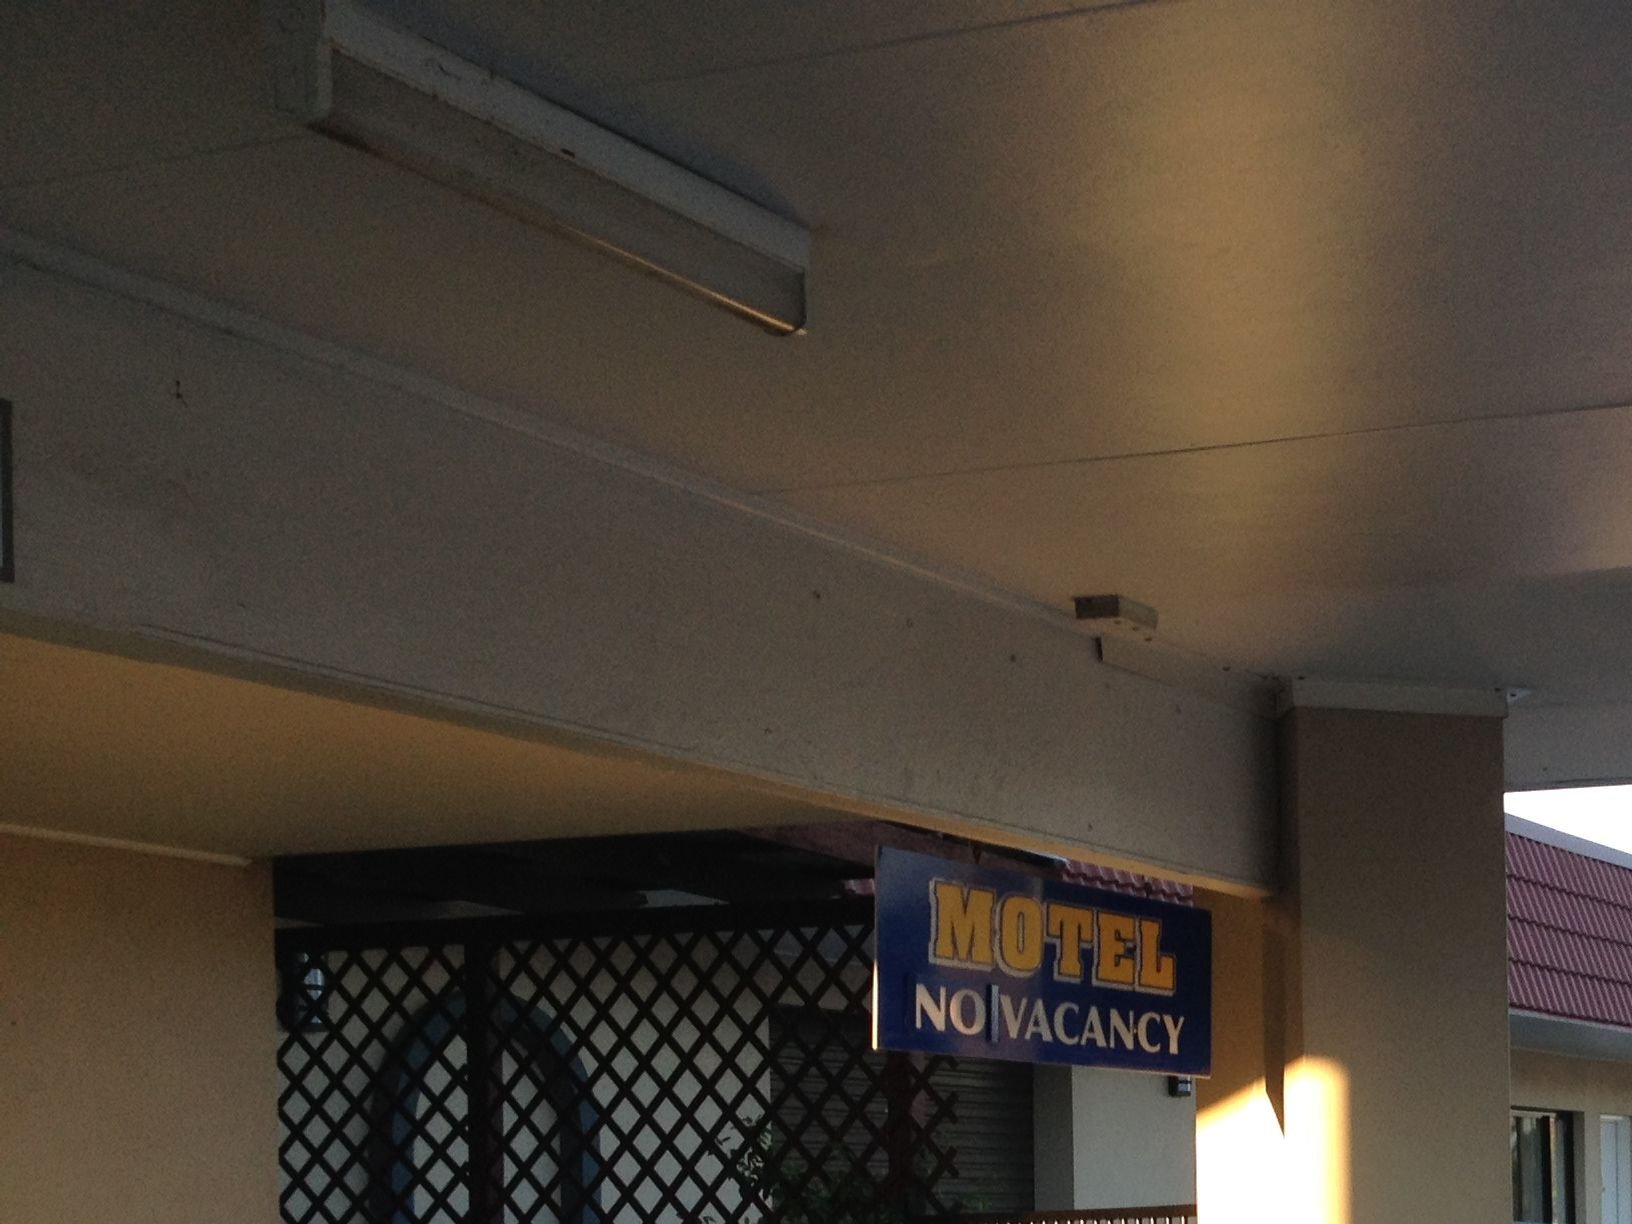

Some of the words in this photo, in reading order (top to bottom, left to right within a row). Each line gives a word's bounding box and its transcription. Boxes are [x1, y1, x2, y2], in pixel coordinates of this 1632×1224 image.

[929, 877, 1177, 997] MOTEL
[915, 983, 987, 1036] NO
[1000, 995, 1185, 1055] VACANCY
